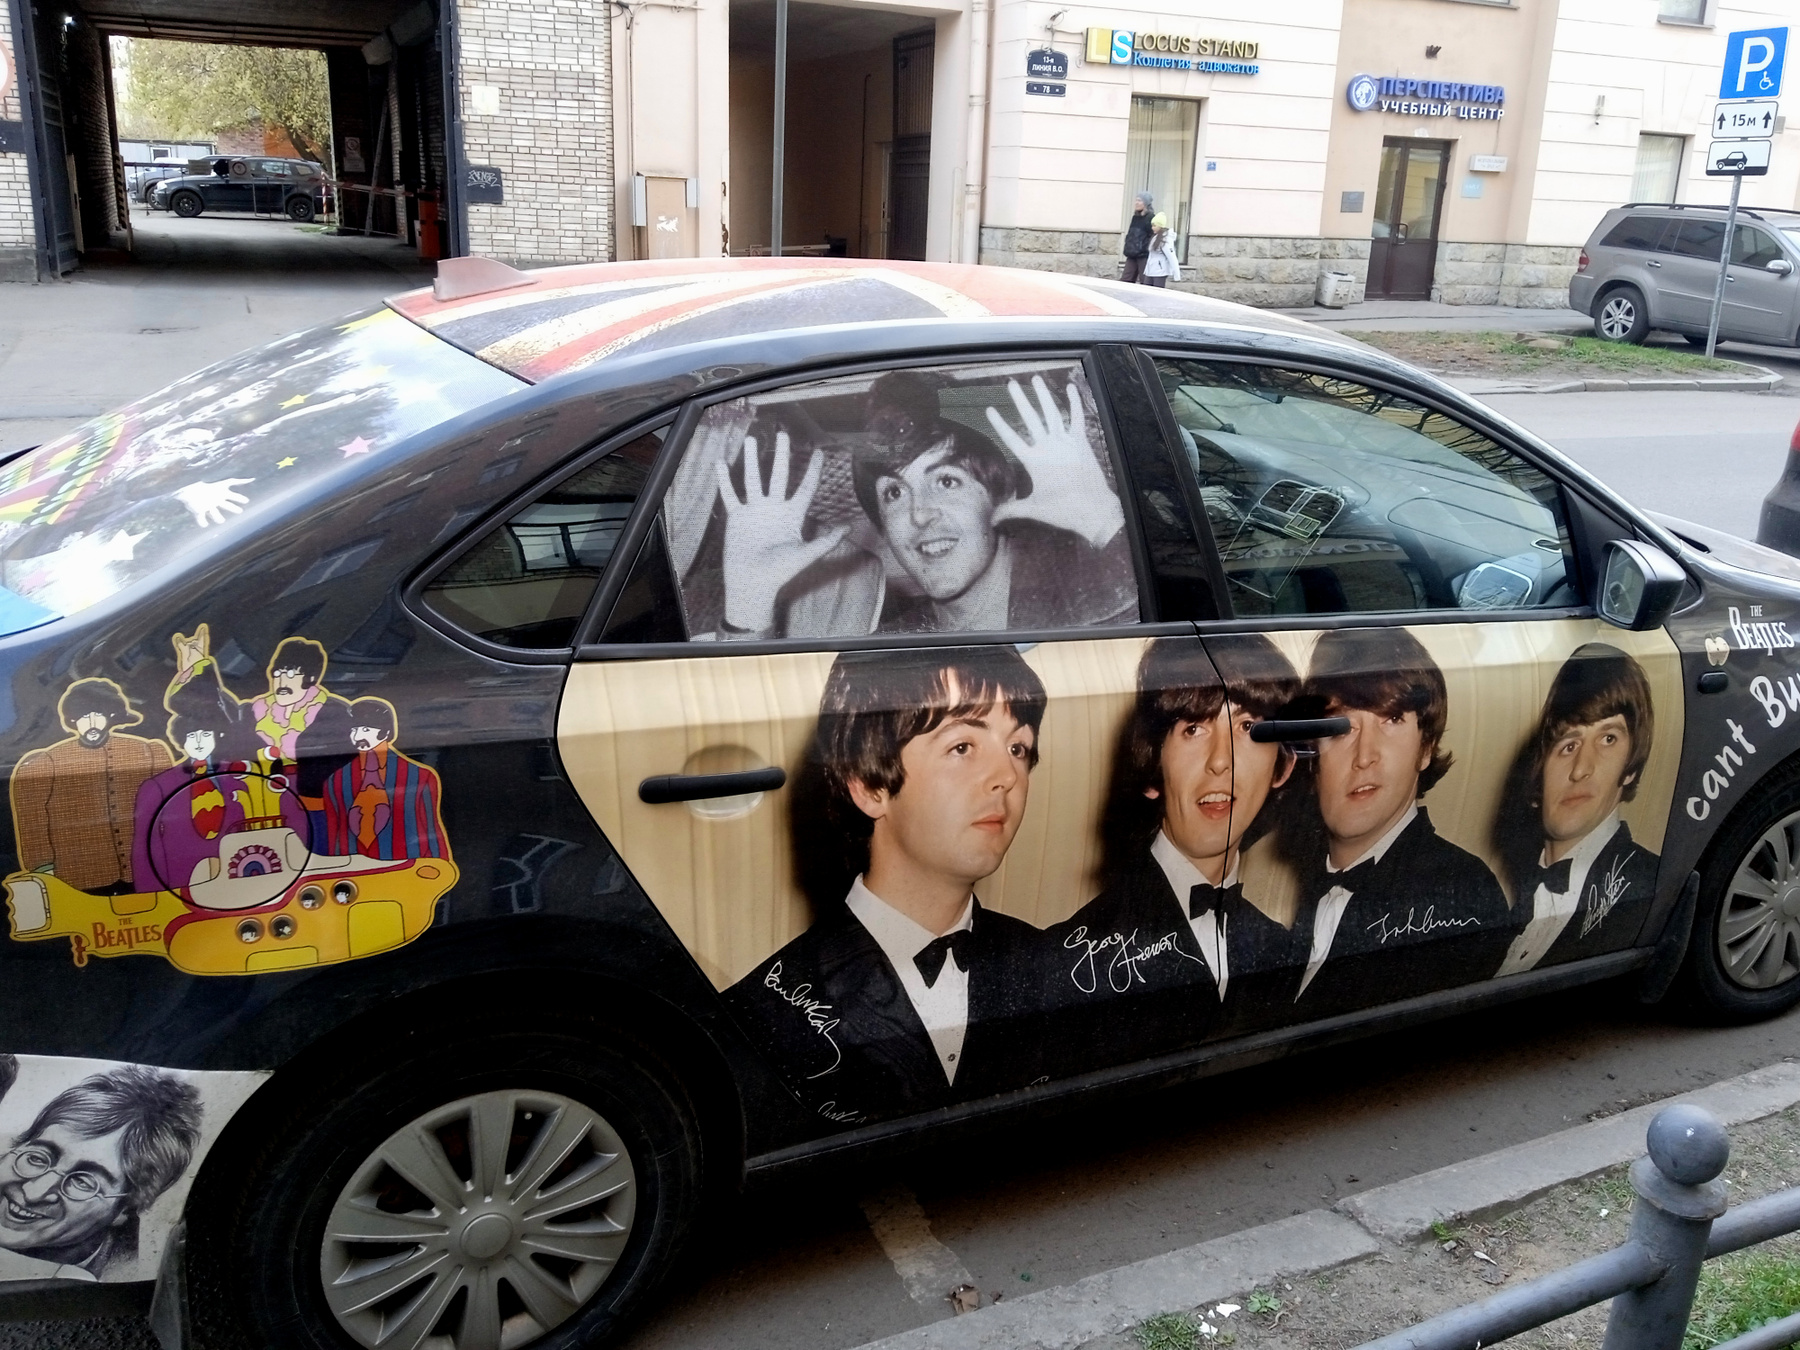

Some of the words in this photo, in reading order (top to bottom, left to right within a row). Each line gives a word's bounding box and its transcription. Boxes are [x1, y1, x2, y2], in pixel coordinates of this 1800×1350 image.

[1133, 32, 1191, 54] LOCUS
[1032, 64, 1052, 72] ЛИНИЯ
[1132, 51, 1192, 70] Коллегия
[1736, 36, 1775, 92] P
[1380, 77, 1505, 104] ПЕРСПЕКТИВА
[1381, 100, 1452, 117] УЧЕБНЫЙ
[1459, 106, 1505, 121] ЦЕНТР
[1750, 605, 1763, 617] THE
[1728, 606, 1795, 656] BEATLES
[1749, 672, 1800, 728] Bu
[118, 917, 133, 926] THE
[92, 922, 163, 950] BEATLES
